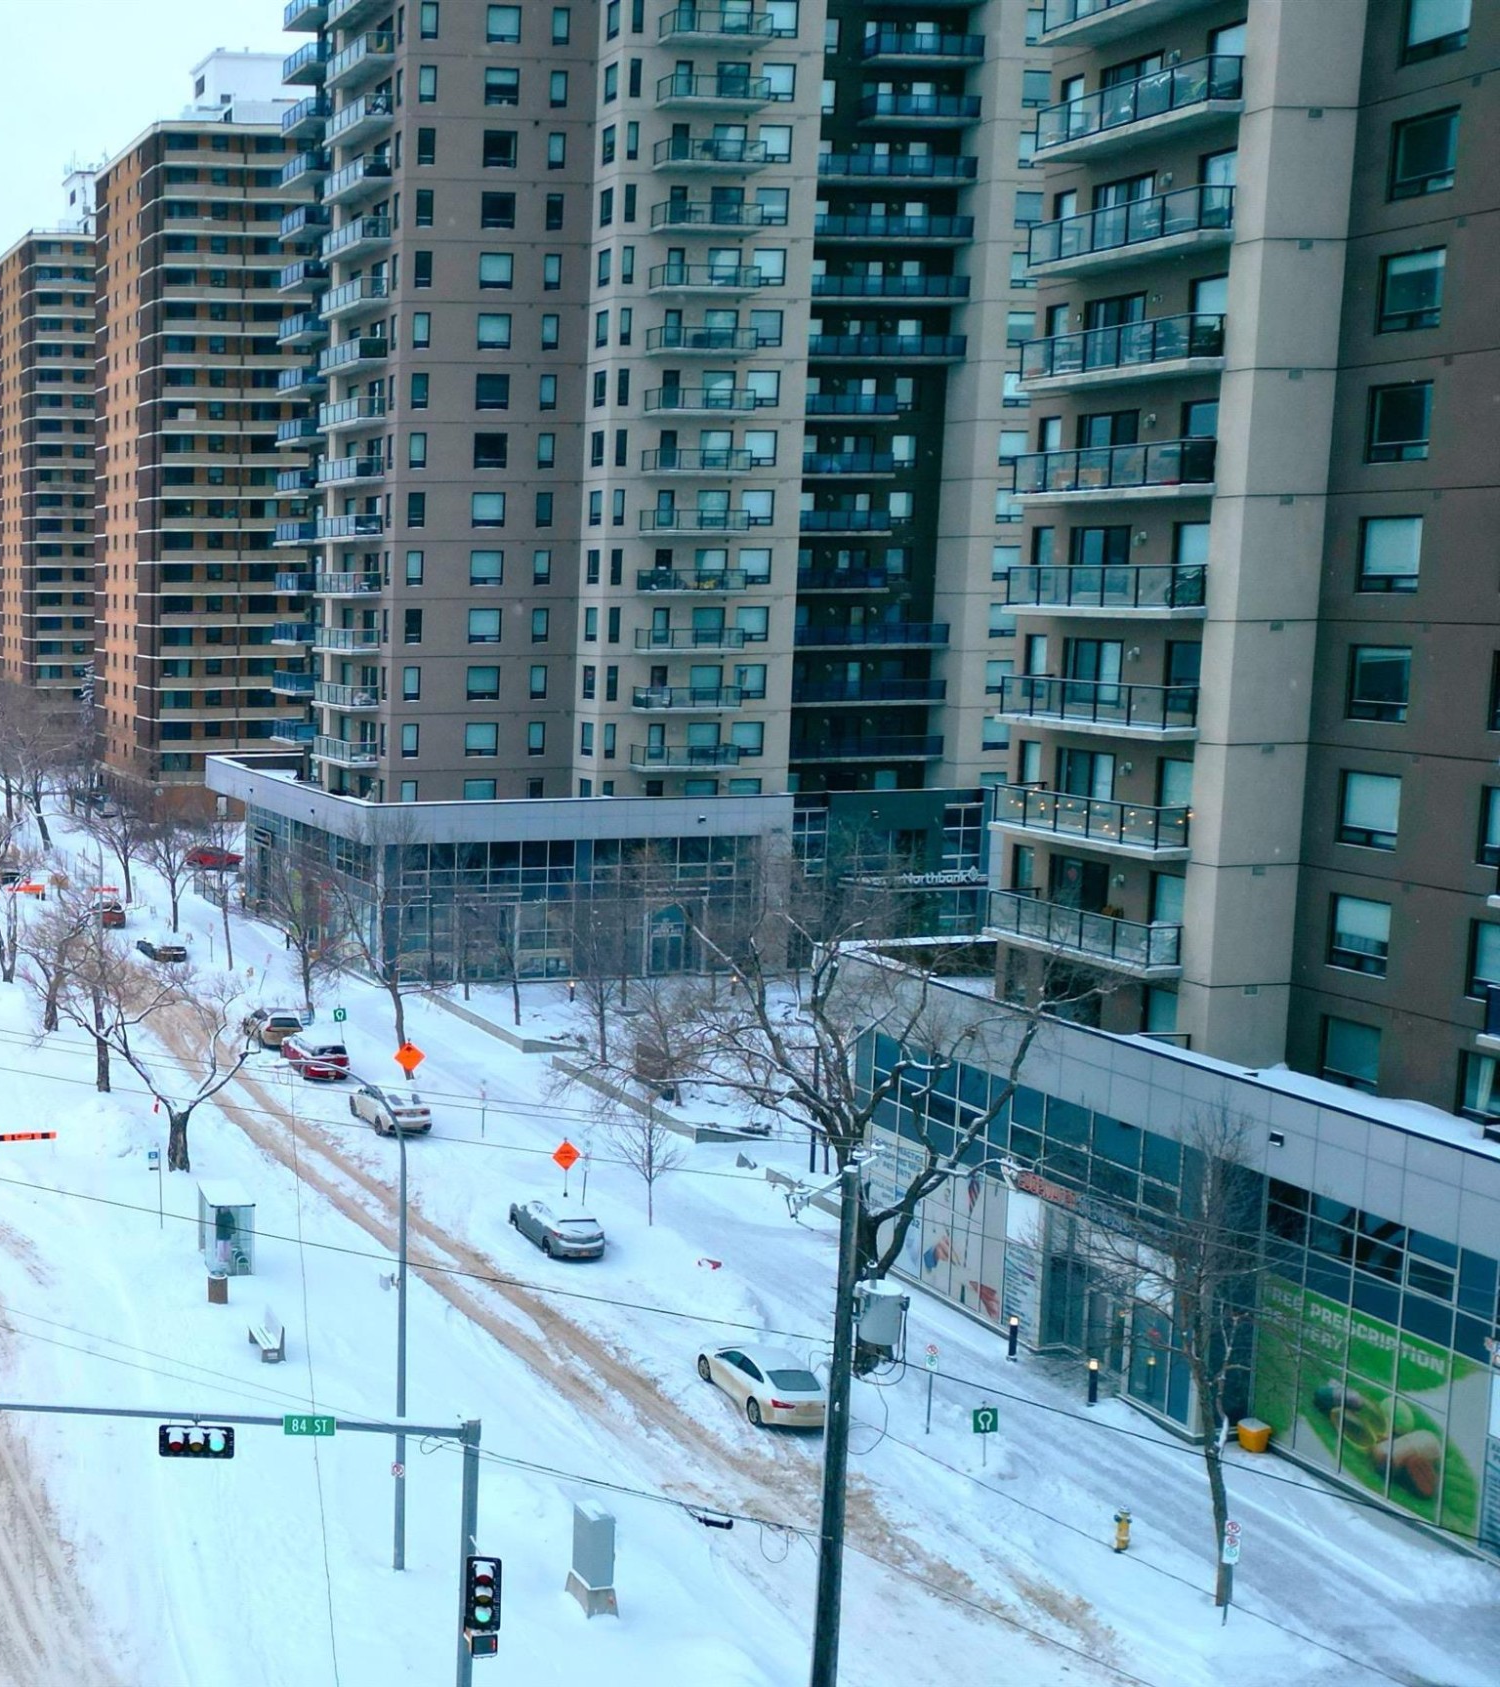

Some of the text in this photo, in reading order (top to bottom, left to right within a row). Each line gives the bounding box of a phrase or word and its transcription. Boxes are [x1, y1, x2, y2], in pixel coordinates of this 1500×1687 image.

[902, 871, 969, 885] Northbank
[1263, 1285, 1303, 1311] FREE
[1310, 1303, 1445, 1374] PRESCRIPTION
[291, 1418, 328, 1433] 84 ST
